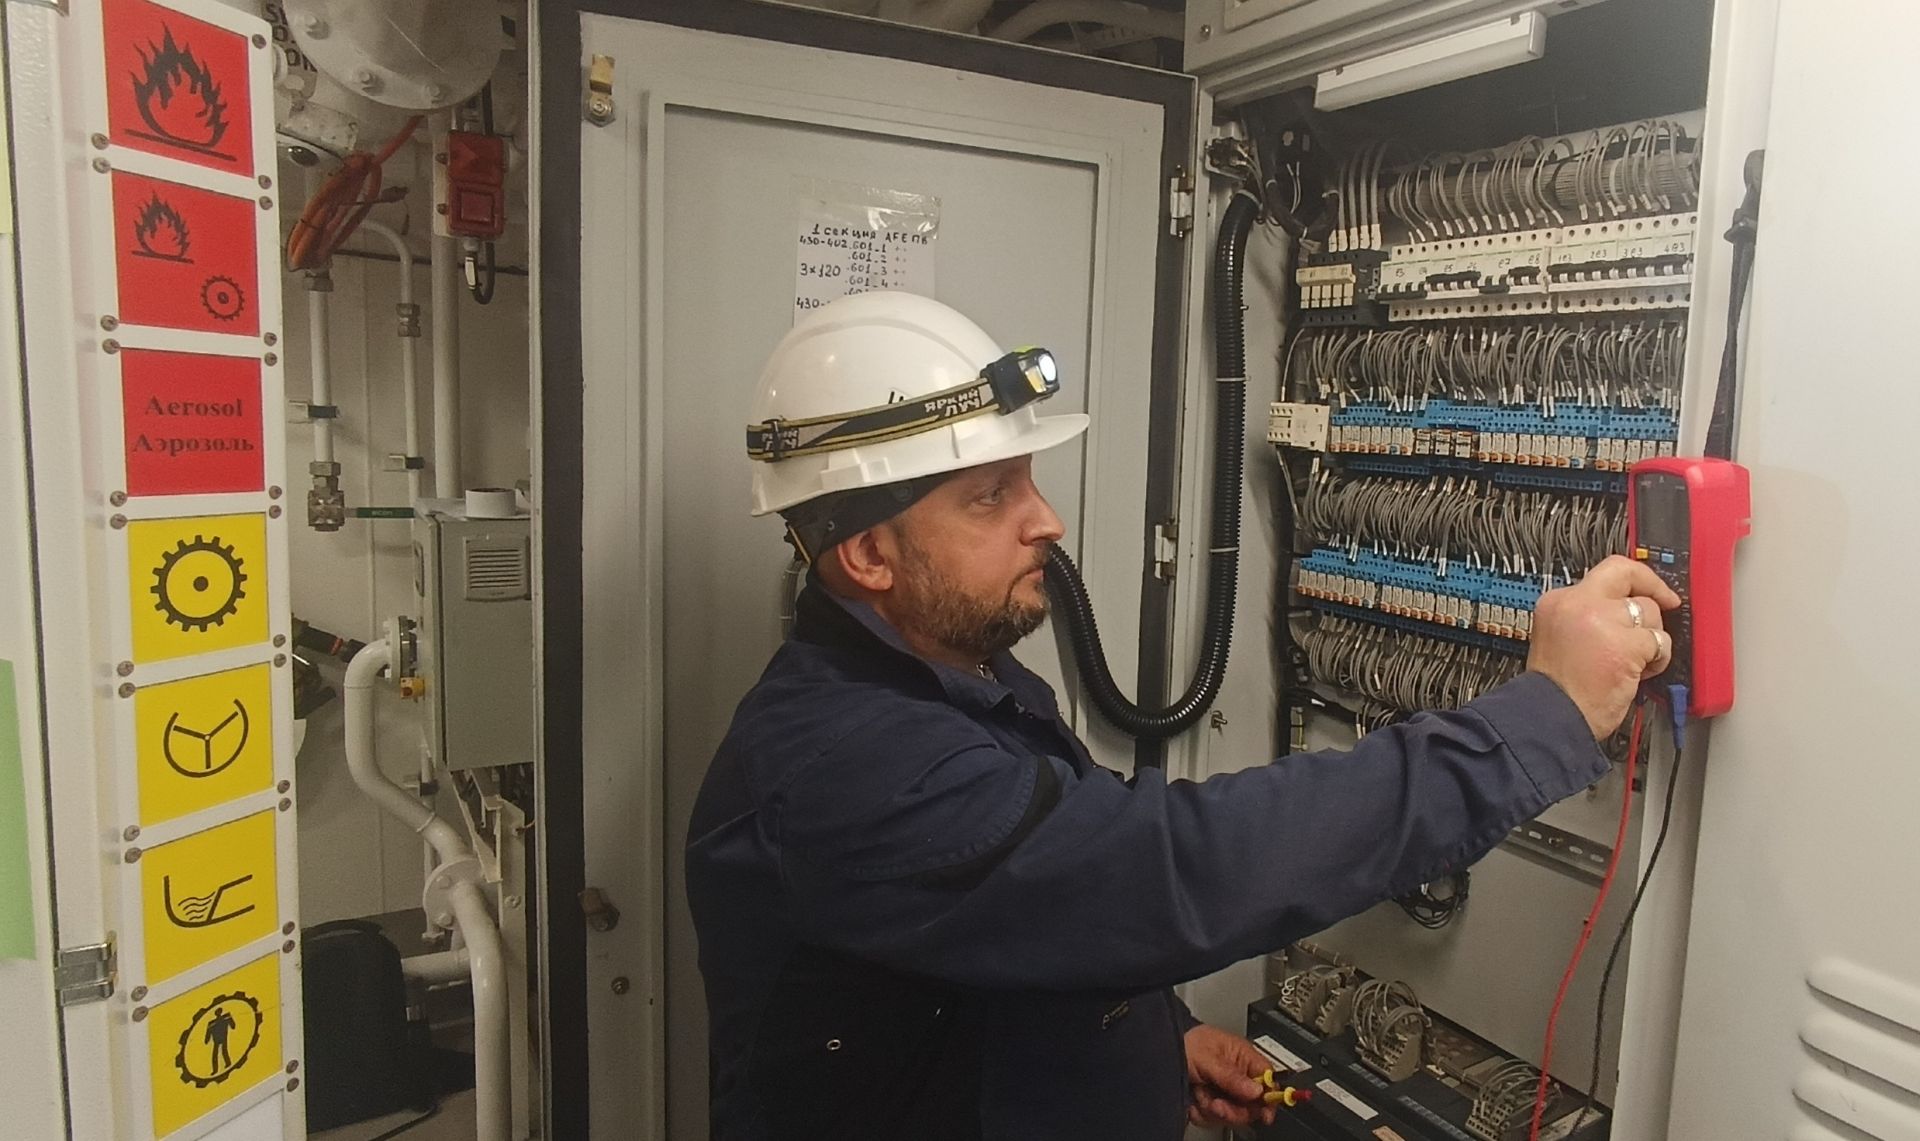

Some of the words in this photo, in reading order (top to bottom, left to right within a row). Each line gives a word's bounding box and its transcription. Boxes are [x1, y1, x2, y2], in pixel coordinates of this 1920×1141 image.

[145, 395, 243, 417] Aerosol
[925, 388, 978, 413] ЯРКИЙ
[945, 398, 980, 417] ЛУЧ
[134, 434, 255, 457] Аэрозоль
